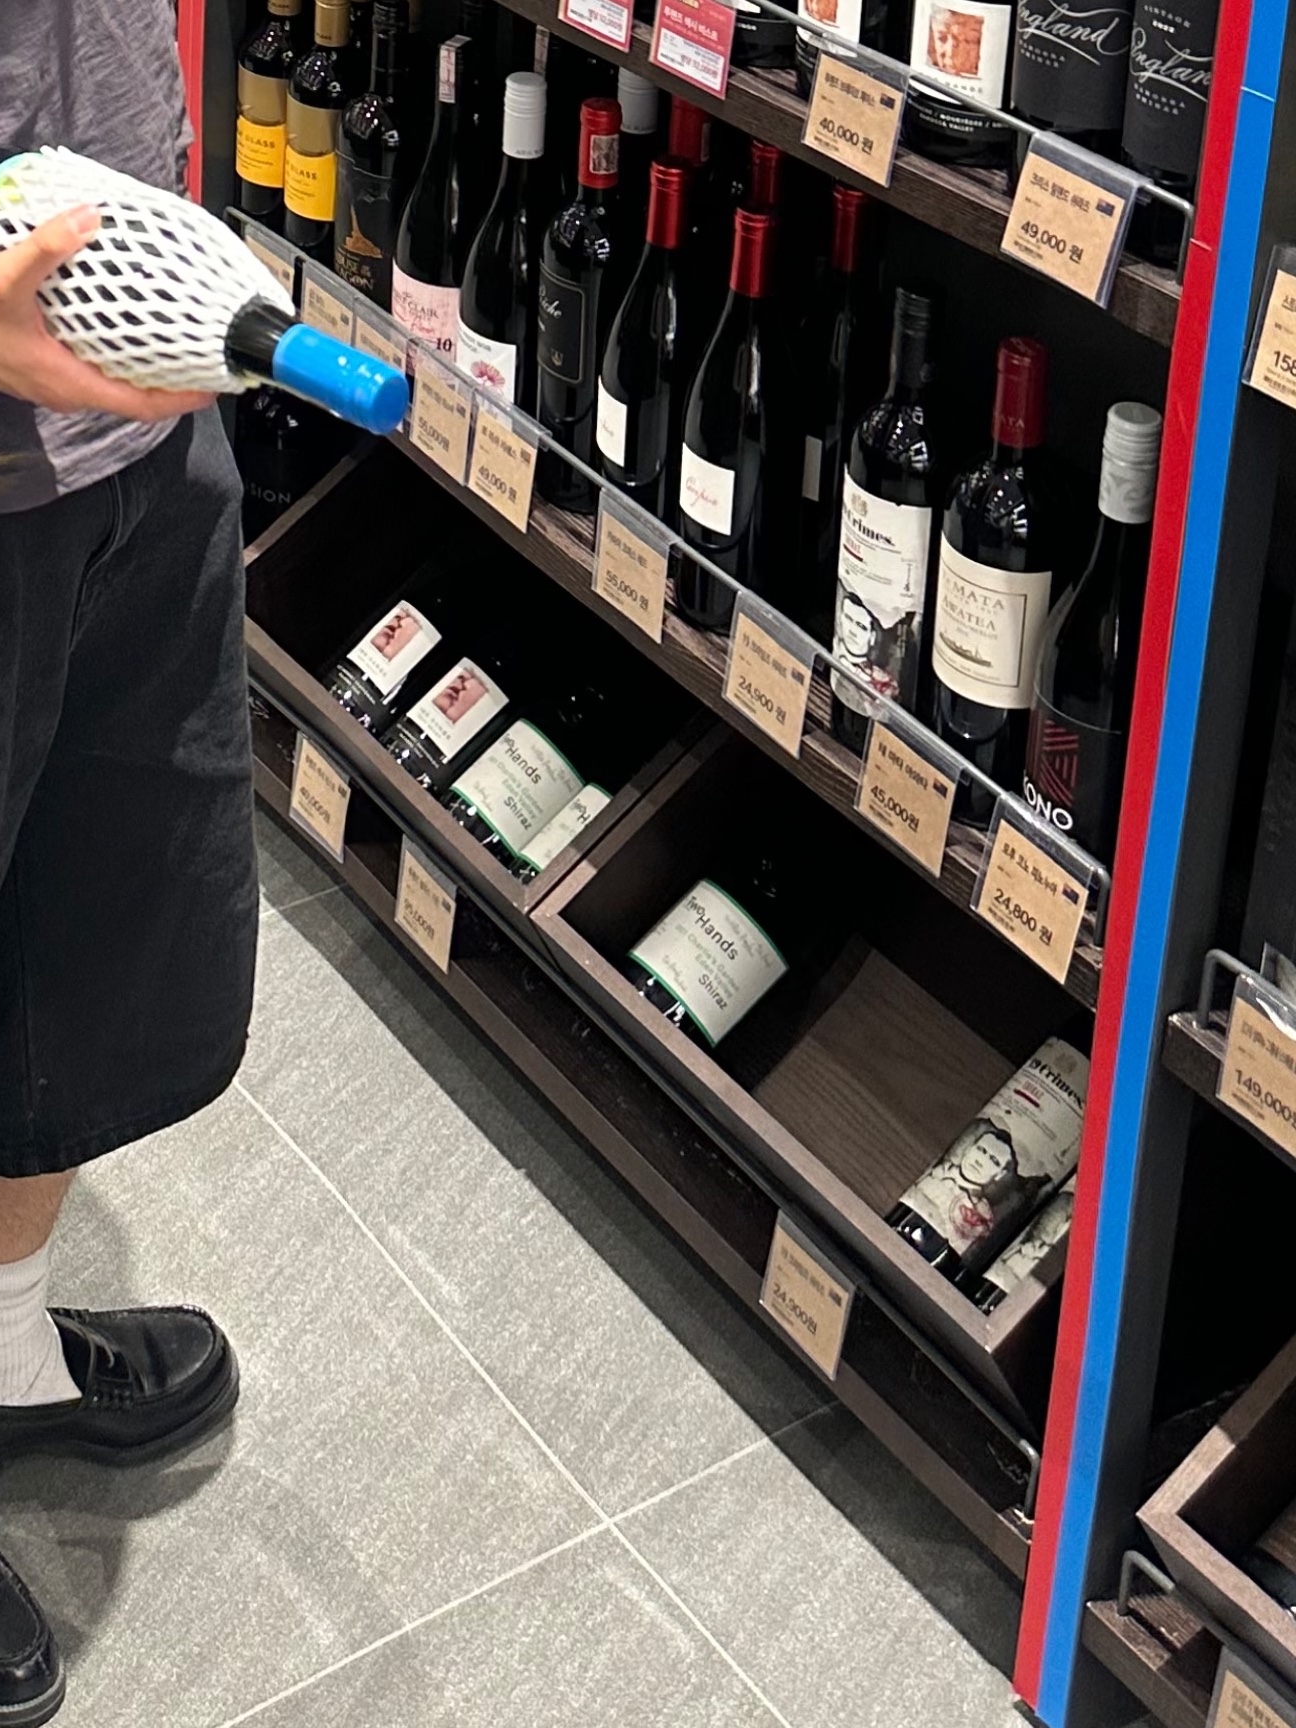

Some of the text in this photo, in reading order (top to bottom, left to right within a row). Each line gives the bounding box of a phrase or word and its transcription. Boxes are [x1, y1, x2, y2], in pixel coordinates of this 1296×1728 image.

[819, 117, 874, 156] 40,000 원
[1021, 220, 1084, 265] 49,000 원
[435, 337, 452, 352] 10
[605, 570, 649, 611] 55,000 원
[952, 580, 1005, 610] MATA
[739, 675, 787, 726] 24,900 원
[504, 743, 542, 785] Hands
[503, 795, 533, 831] Shiraz
[871, 784, 920, 833] 45,000원
[686, 895, 706, 917] Two
[994, 888, 1053, 947] 24,800 원
[694, 912, 740, 961] Hands
[697, 973, 729, 1012] Shiraz
